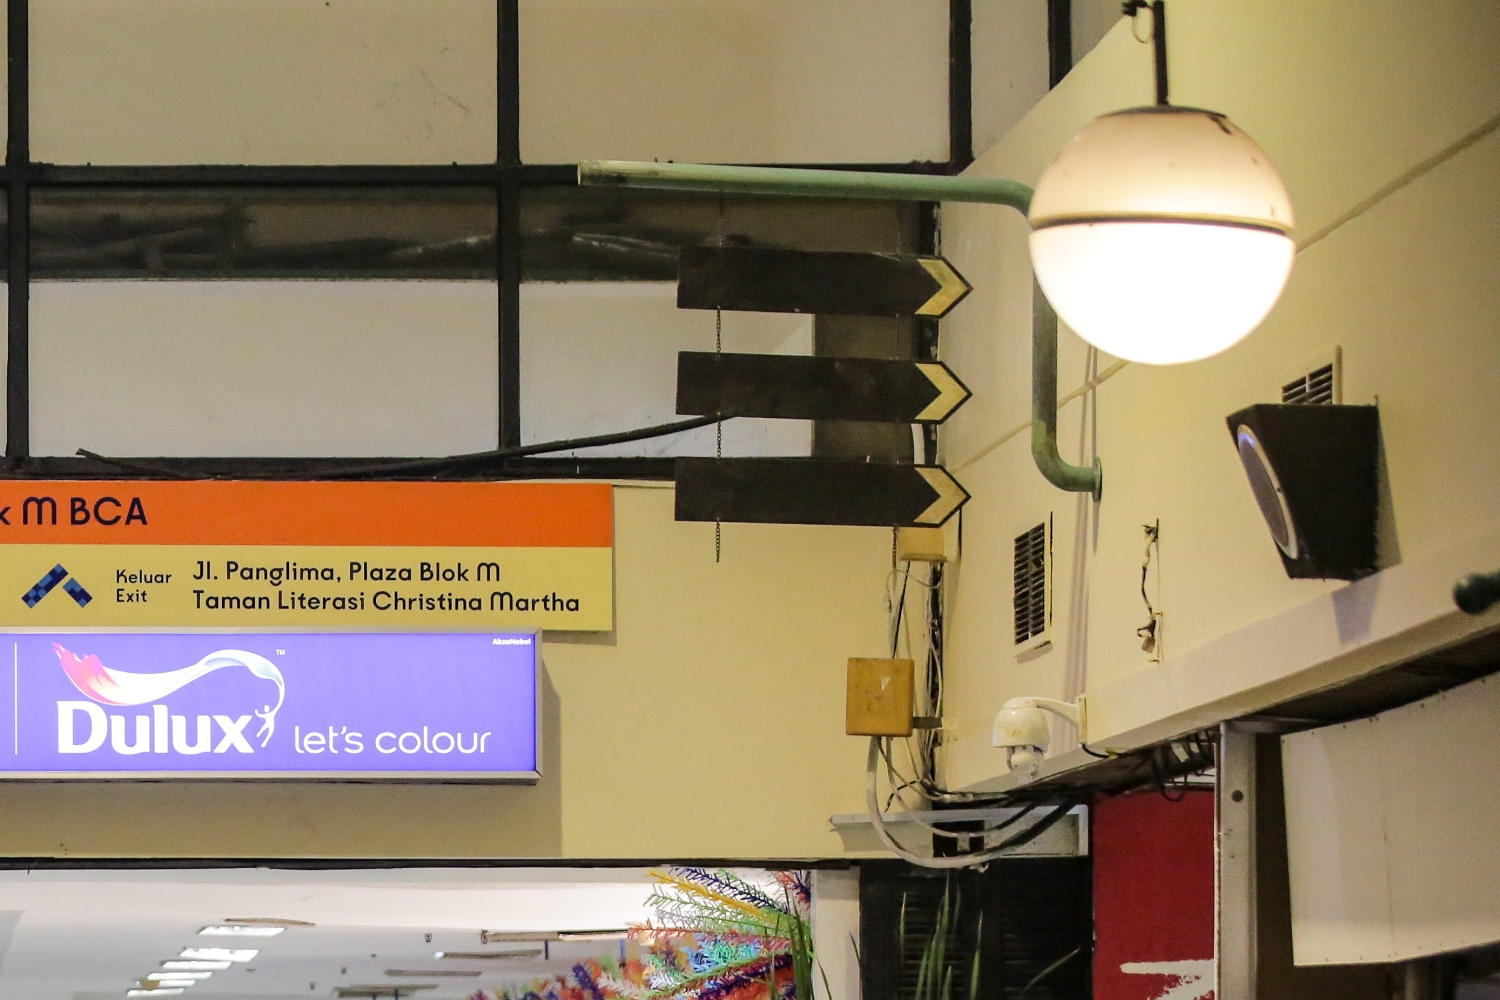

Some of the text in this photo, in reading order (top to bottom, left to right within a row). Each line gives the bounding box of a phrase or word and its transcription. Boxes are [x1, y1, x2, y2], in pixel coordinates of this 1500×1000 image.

[23, 496, 56, 525] M
[70, 496, 148, 525] BCA
[116, 569, 172, 584] Keluar
[192, 561, 500, 586] Jl. Panglima, Plaza Blok M
[116, 588, 148, 603] Exit
[192, 590, 580, 612] Taman Literasi Christina Martha
[56, 700, 255, 755] Dulux
[375, 726, 492, 754] colour
